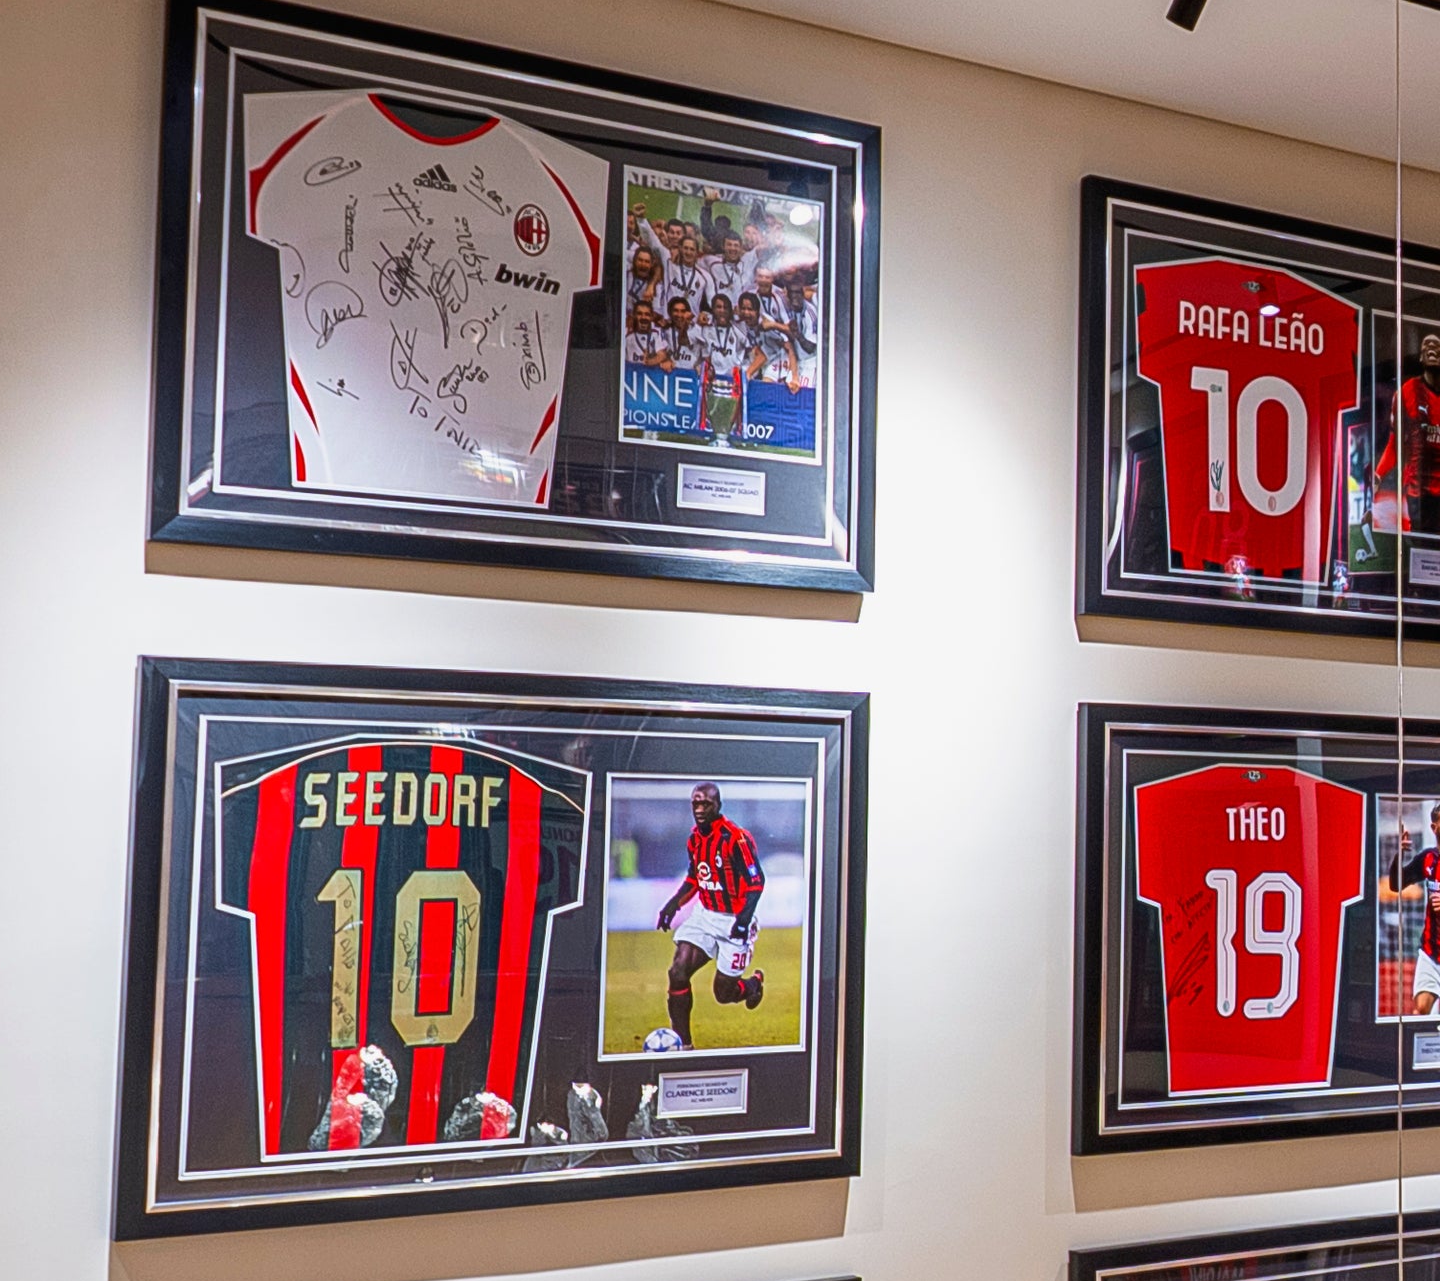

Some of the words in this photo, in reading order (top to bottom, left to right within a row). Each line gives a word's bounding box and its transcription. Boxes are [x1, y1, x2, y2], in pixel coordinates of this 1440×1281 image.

[413, 177, 457, 193] adidas
[495, 263, 560, 296] bwin
[1179, 300, 1250, 344] RAFA
[1259, 312, 1324, 356] LEÃO
[747, 422, 774, 439] 007
[1190, 366, 1308, 517] 10
[299, 771, 505, 829] SEEDORF
[1225, 807, 1285, 841] THEO
[317, 869, 482, 1048] 10
[1205, 869, 1302, 1020] 19
[665, 1089, 705, 1098] CLARENCE
[706, 1087, 738, 1096] SEEDORF
